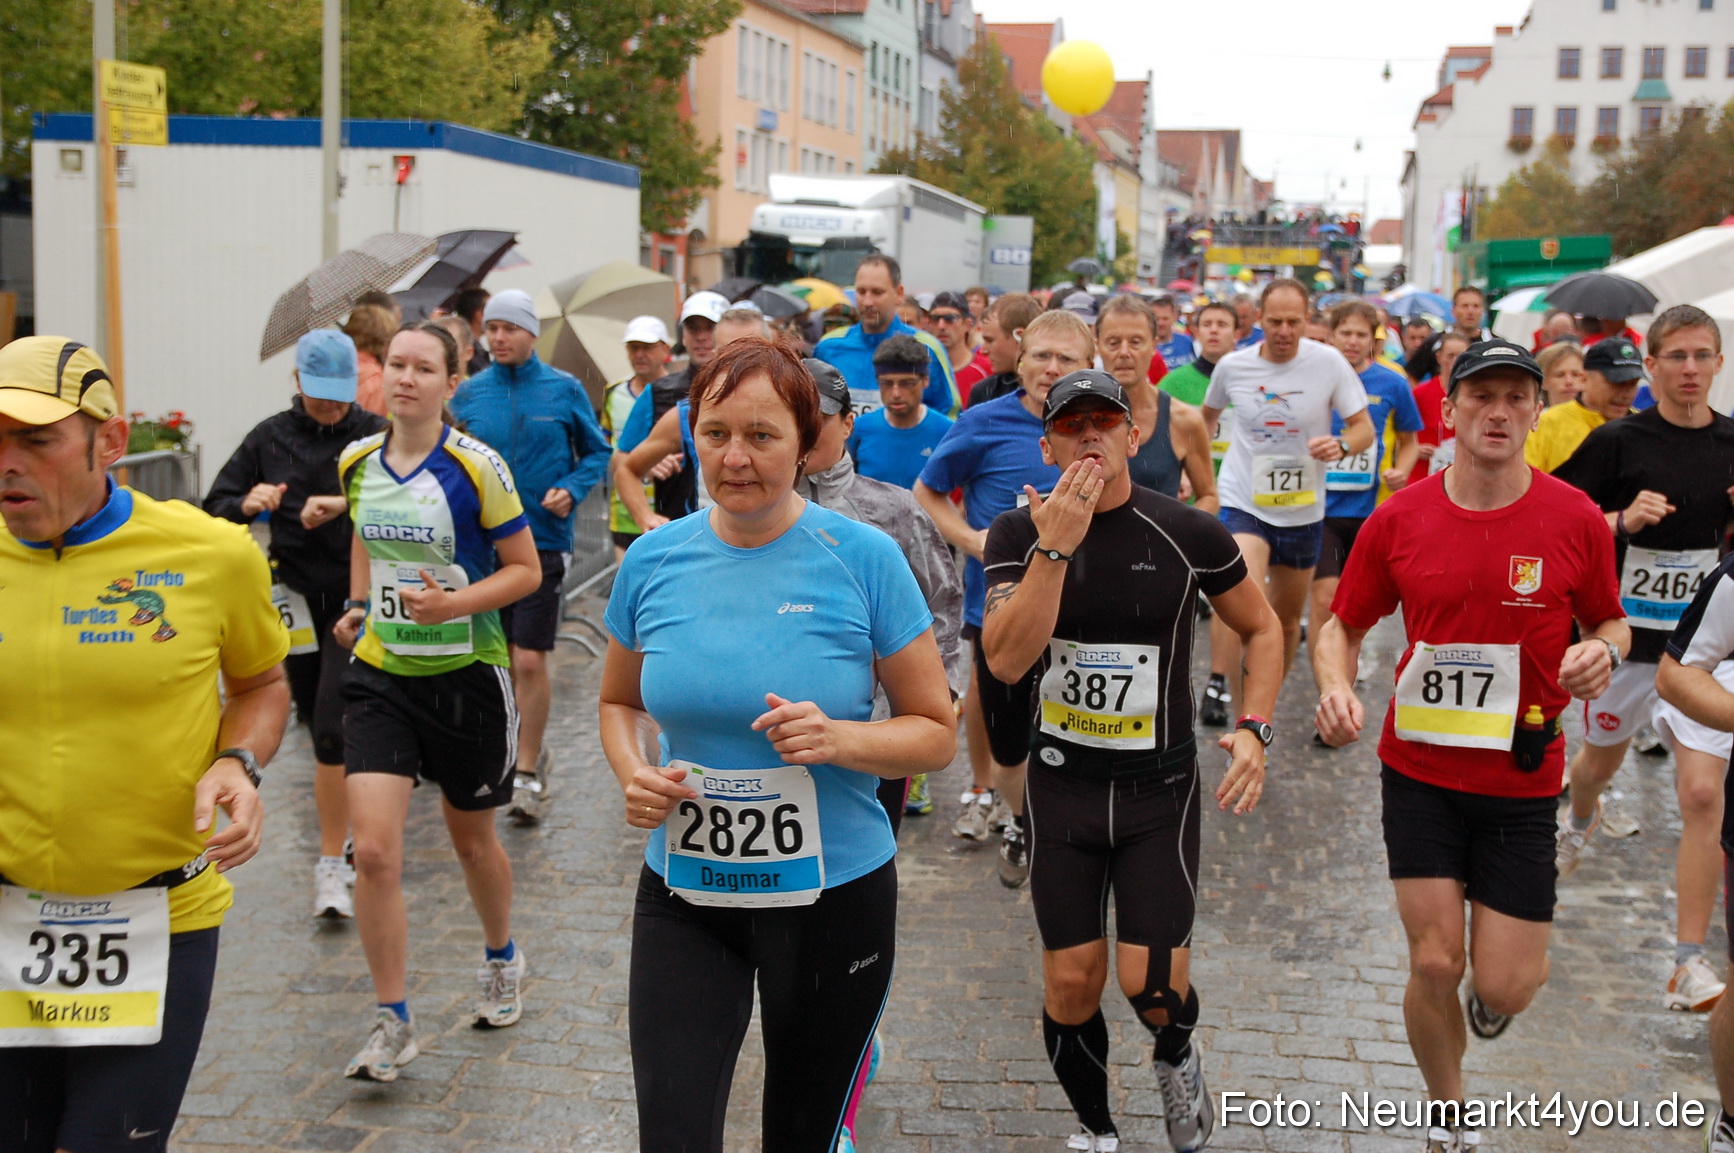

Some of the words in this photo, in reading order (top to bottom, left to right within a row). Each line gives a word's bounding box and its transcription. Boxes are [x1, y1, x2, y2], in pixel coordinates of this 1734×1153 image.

[1326, 453, 1369, 471] 275
[1266, 470, 1303, 491] 121
[365, 509, 408, 522] TEAM
[362, 523, 435, 544] BOCK
[135, 570, 185, 587] Turbo
[1630, 568, 1706, 600] 2464
[61, 606, 118, 625] Turtles
[789, 604, 814, 612] asics
[1635, 603, 1687, 618] Sebasti
[79, 631, 134, 644] Roth
[396, 628, 442, 642] Kathrin
[1076, 650, 1121, 662] BOCK
[1434, 649, 1482, 661] BOCK
[1061, 669, 1133, 712] 387
[1421, 669, 1494, 707] 817
[1067, 712, 1123, 734] Richard
[703, 776, 762, 792] BOCK
[679, 800, 804, 857] 2826
[701, 866, 781, 892] Dagmar
[40, 900, 112, 917] BOCK
[21, 930, 129, 988] 335
[860, 952, 879, 969] asics
[28, 999, 111, 1022] Markus
